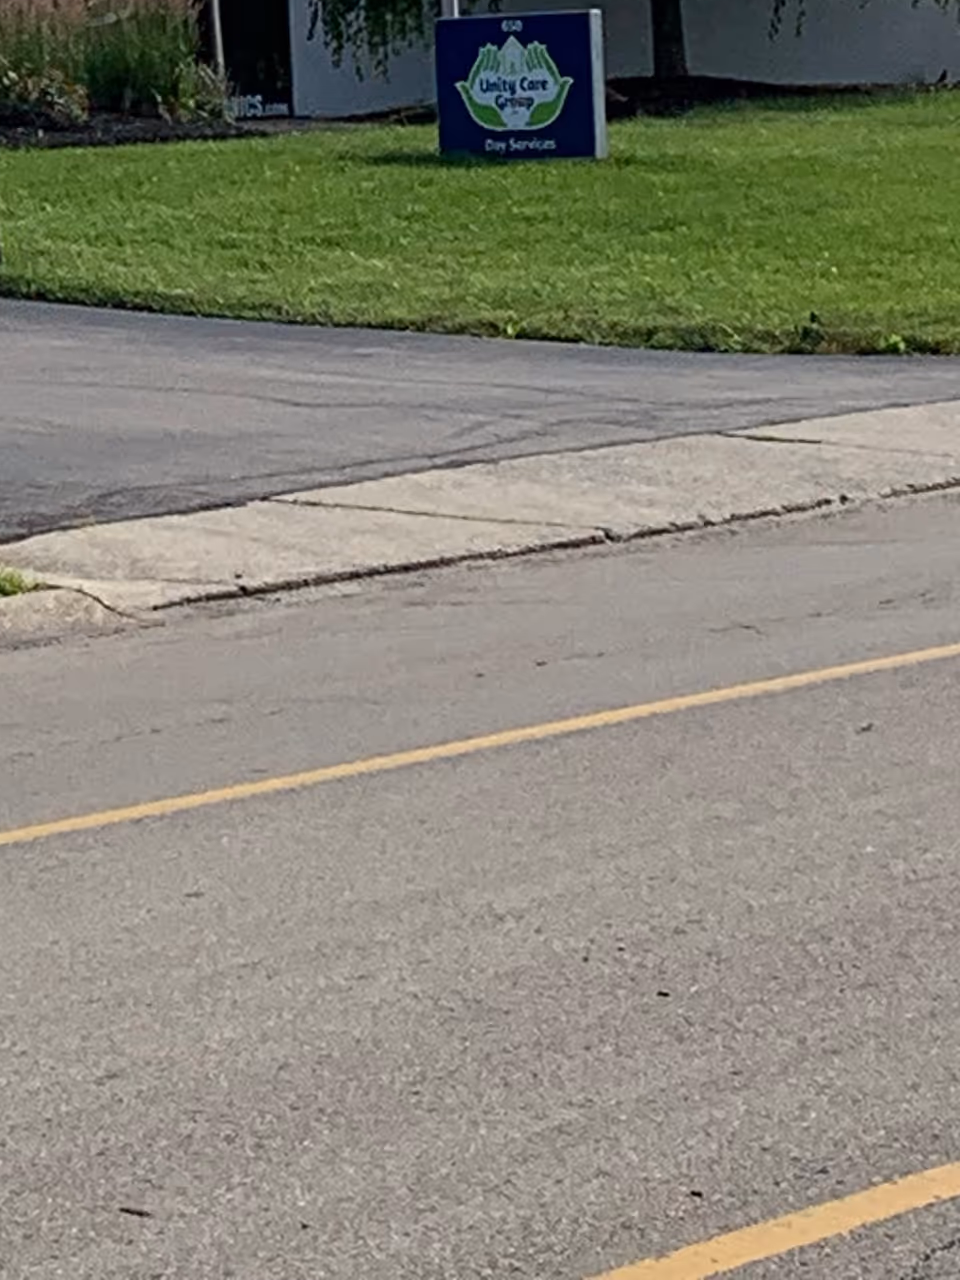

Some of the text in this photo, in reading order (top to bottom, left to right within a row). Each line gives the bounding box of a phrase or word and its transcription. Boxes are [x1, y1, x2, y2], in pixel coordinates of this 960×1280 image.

[479, 76, 549, 95] Unity Care
[495, 94, 535, 111] Group
[484, 137, 556, 153] Day Services
